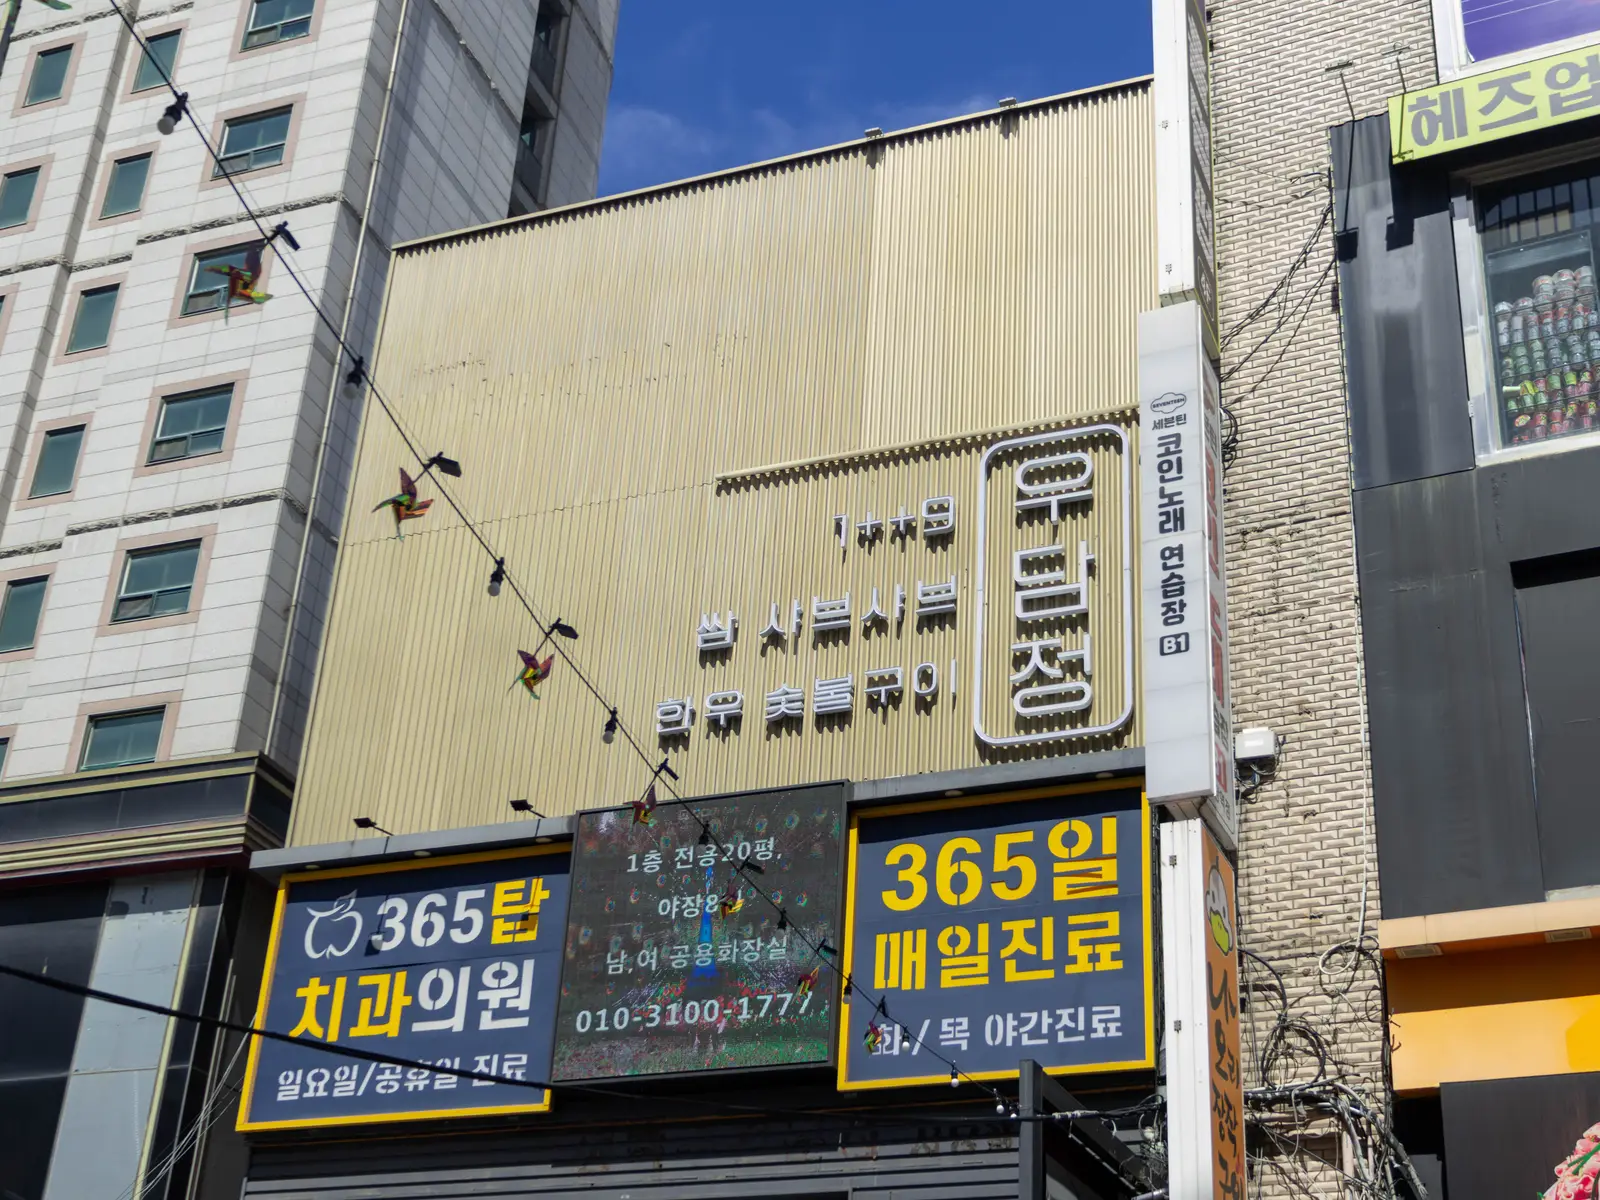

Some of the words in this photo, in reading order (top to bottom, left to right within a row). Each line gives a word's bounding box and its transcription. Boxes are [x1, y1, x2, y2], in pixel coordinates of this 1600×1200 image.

[1408, 53, 1600, 147] 헤즈업
[1151, 413, 1187, 431] 세븐틴
[1156, 432, 1186, 535] 코인노래
[696, 609, 738, 650] 쌈
[759, 575, 958, 640] 샤브샤브
[1159, 543, 1187, 627] 연습장
[1162, 634, 1188, 655] B1
[656, 690, 745, 735] 한우
[765, 658, 958, 722] 숯불구이
[626, 850, 663, 873] 1층
[881, 815, 1119, 912] 365일
[371, 877, 550, 952] 365탑
[874, 911, 1123, 991] 매일진료
[669, 936, 788, 969] 공용화장실
[289, 959, 535, 1043] 치과의원
[984, 1006, 1123, 1047] 야간진료
[472, 1054, 528, 1088] 진료
